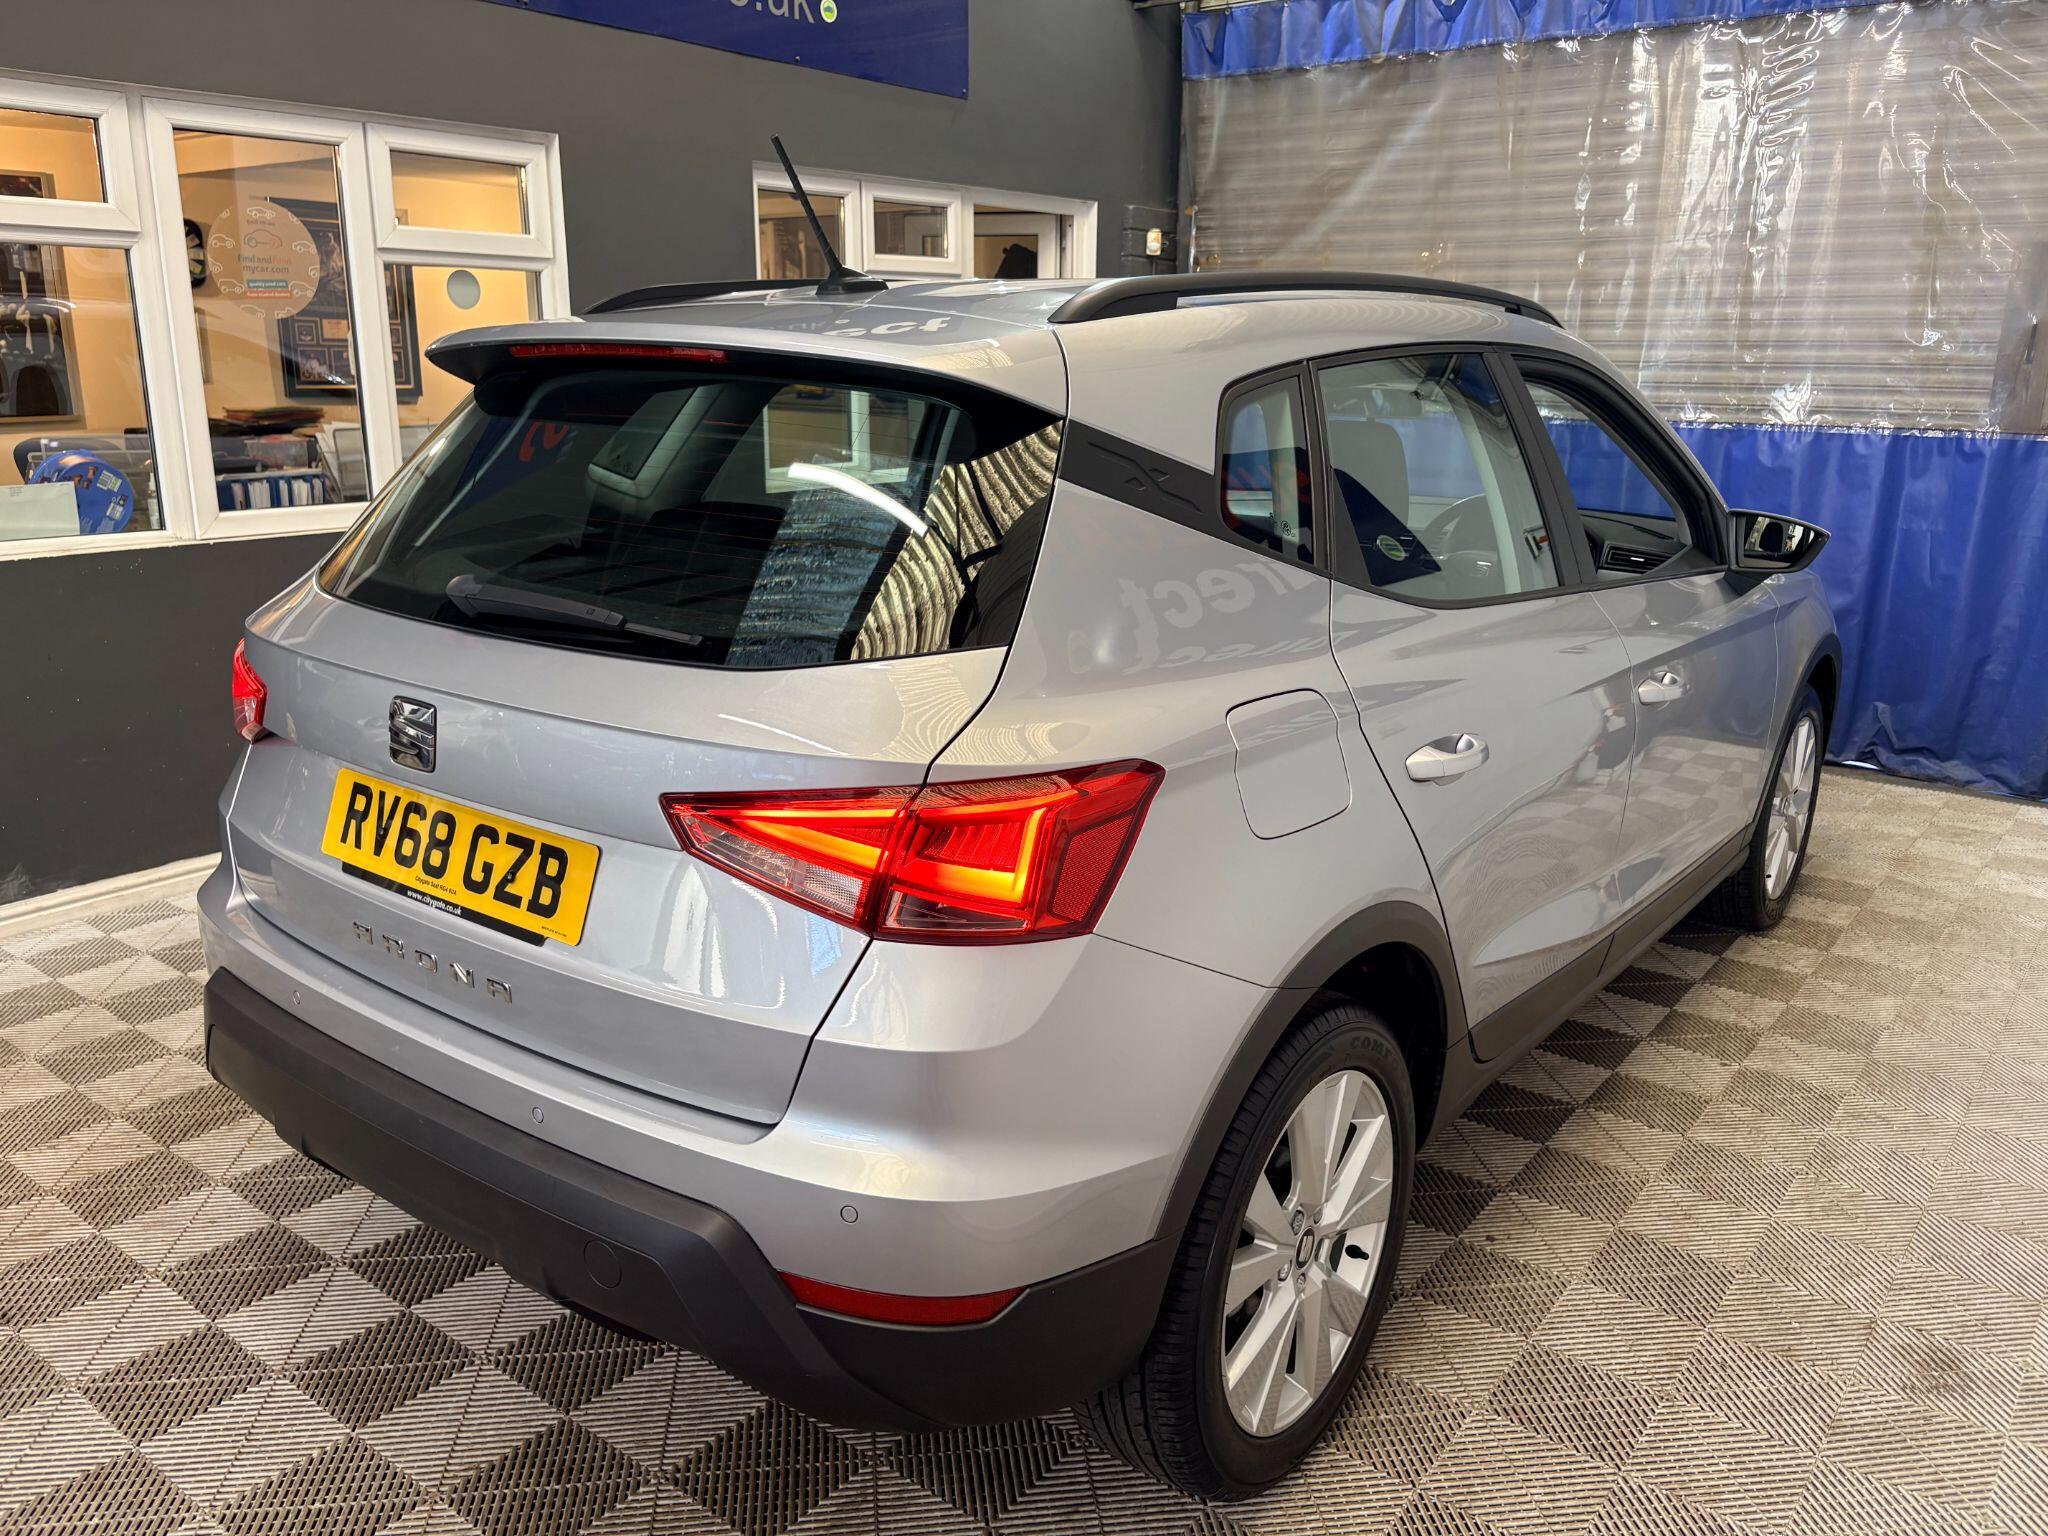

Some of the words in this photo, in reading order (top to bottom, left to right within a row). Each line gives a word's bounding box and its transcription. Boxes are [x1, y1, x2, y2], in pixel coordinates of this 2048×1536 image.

[340, 781, 457, 880] RV68
[462, 823, 568, 919] GZB
[407, 889, 462, 916] www.citygate.co.uk
[353, 921, 513, 1004] ARONA
